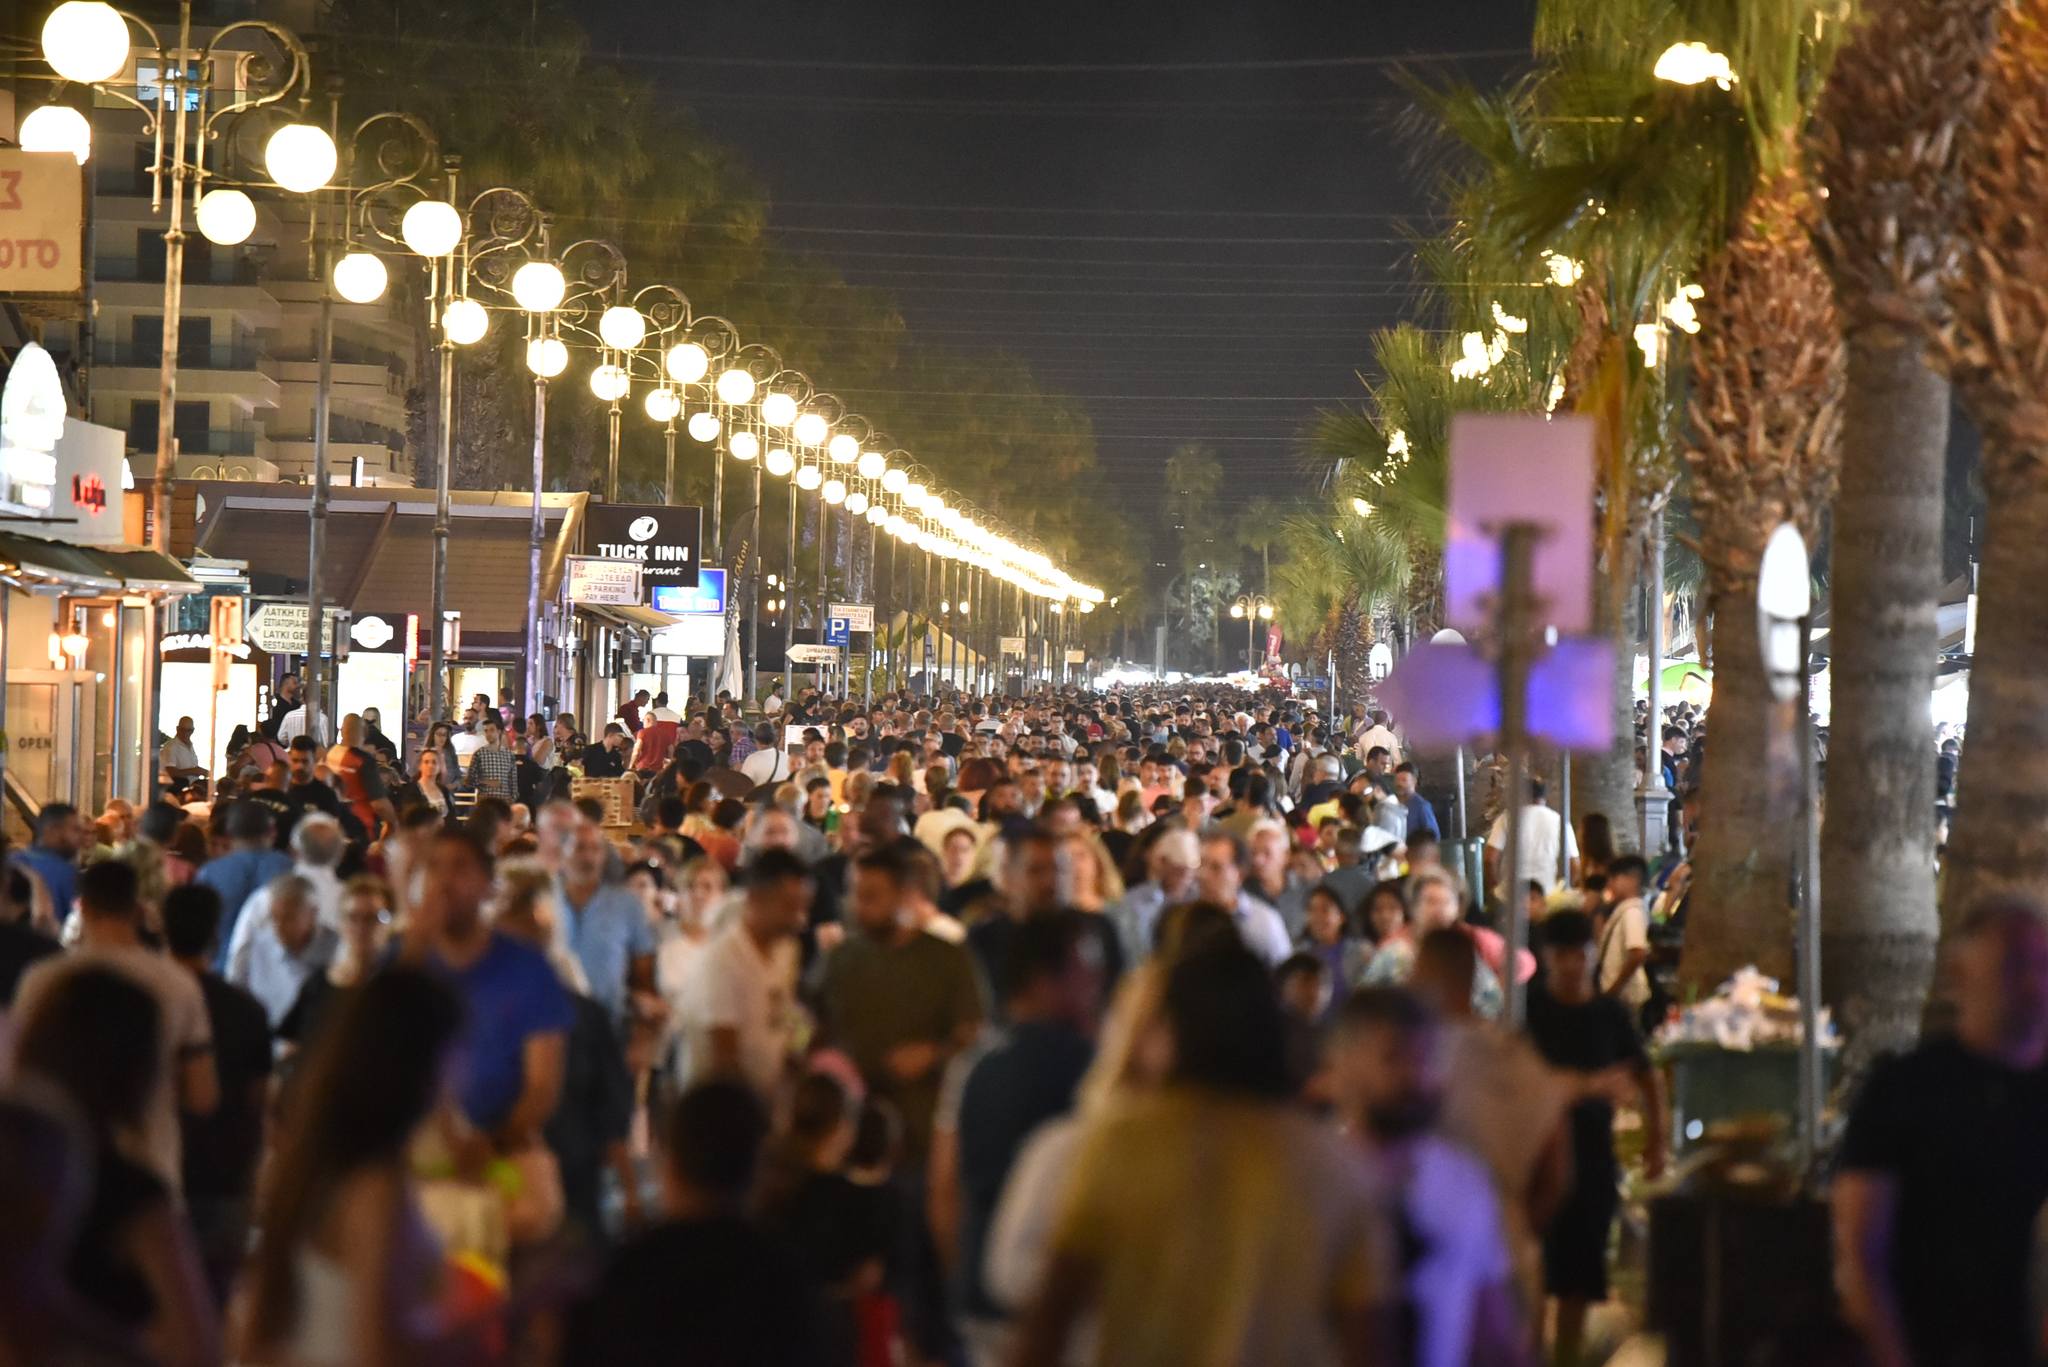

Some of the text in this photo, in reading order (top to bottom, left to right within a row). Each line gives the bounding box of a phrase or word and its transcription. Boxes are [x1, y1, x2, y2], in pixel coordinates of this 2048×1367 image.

[597, 544, 688, 561] TUCK INN
[641, 566, 684, 576] urant
[594, 585, 627, 594] PARKING
[599, 594, 620, 602] HERE
[831, 618, 846, 636] P
[18, 736, 53, 750] OPEN
